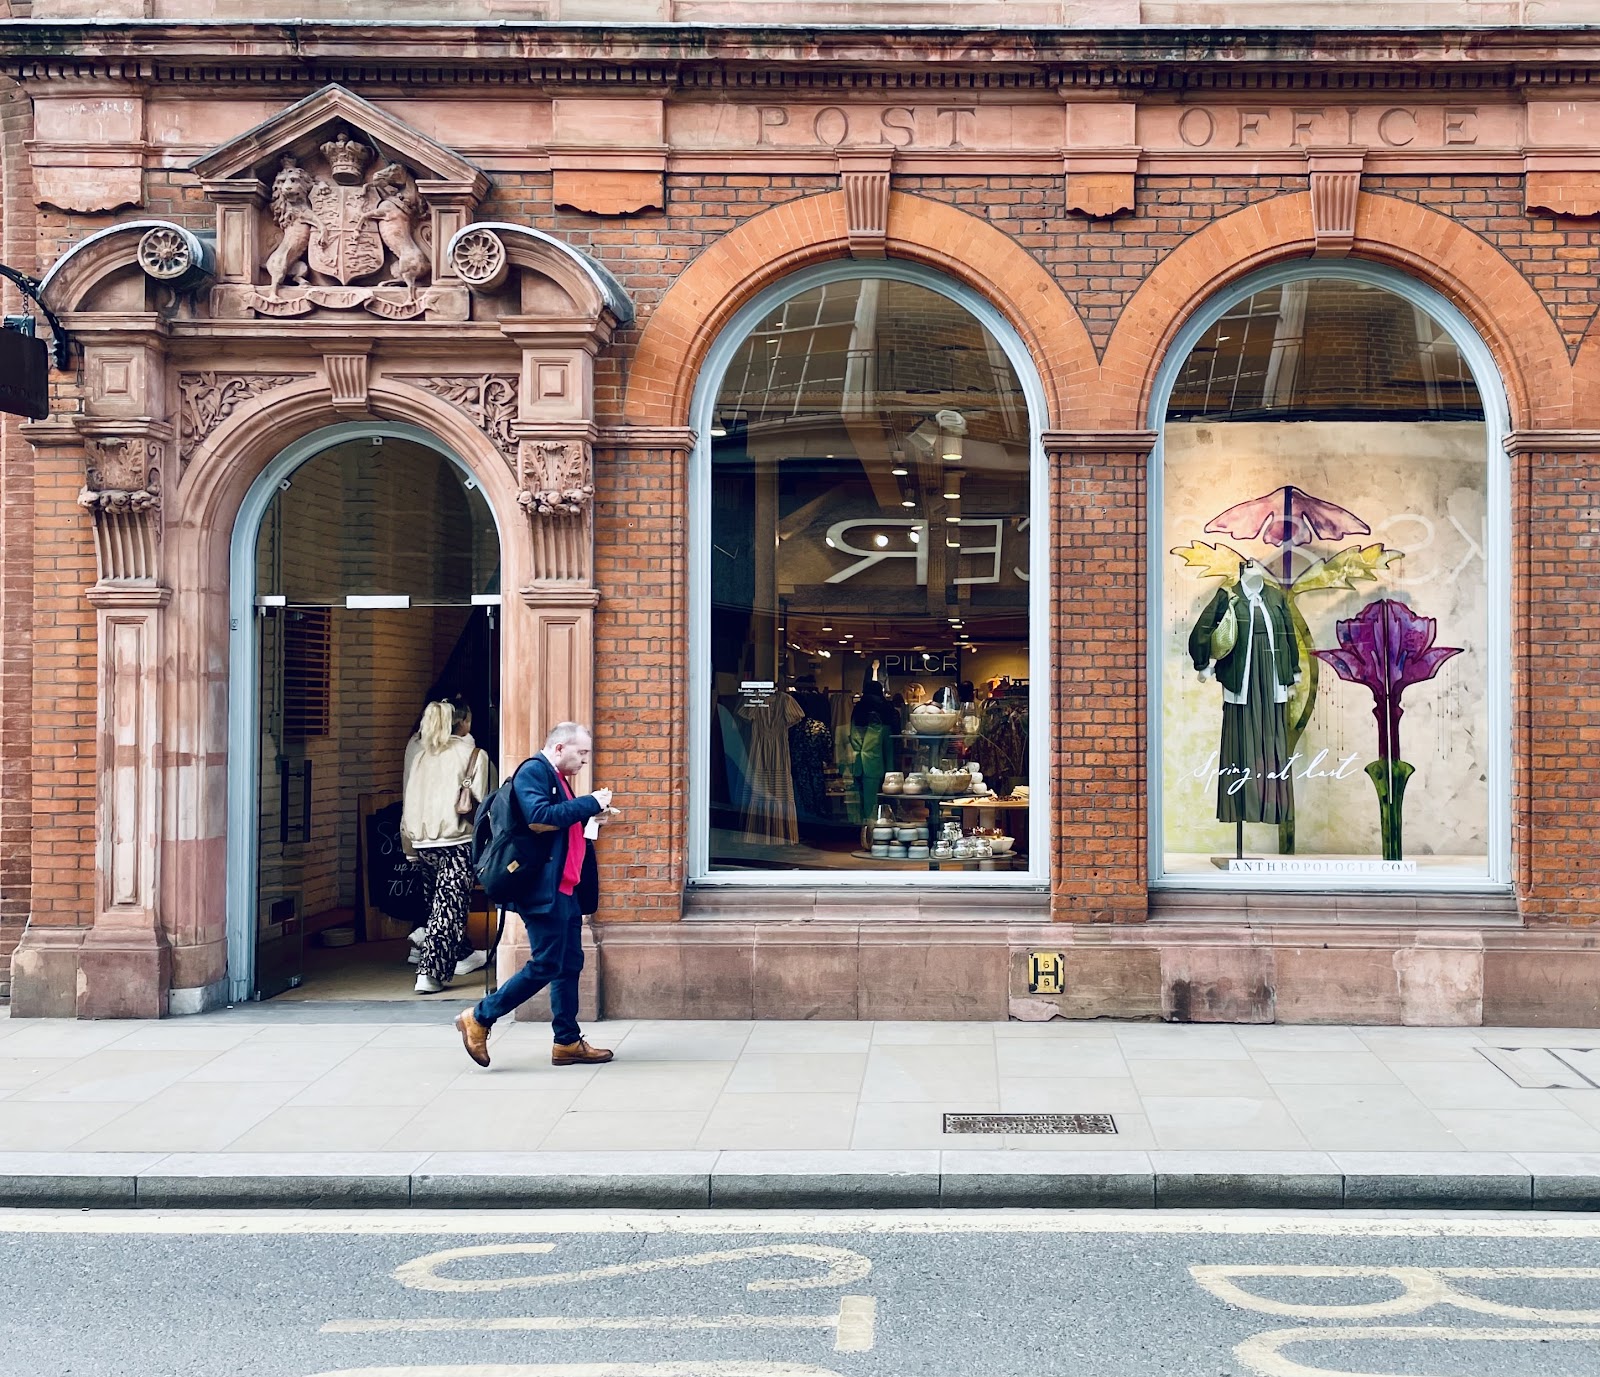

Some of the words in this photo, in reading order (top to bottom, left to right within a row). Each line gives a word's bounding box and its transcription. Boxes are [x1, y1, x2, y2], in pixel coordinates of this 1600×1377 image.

[755, 106, 976, 147] POST
[1178, 107, 1478, 147] OFFICE
[1266, 752, 1303, 781] at
[1296, 748, 1362, 780] last
[387, 878, 415, 897] 70%
[1043, 960, 1050, 969] 6
[1043, 977, 1050, 987] 6
